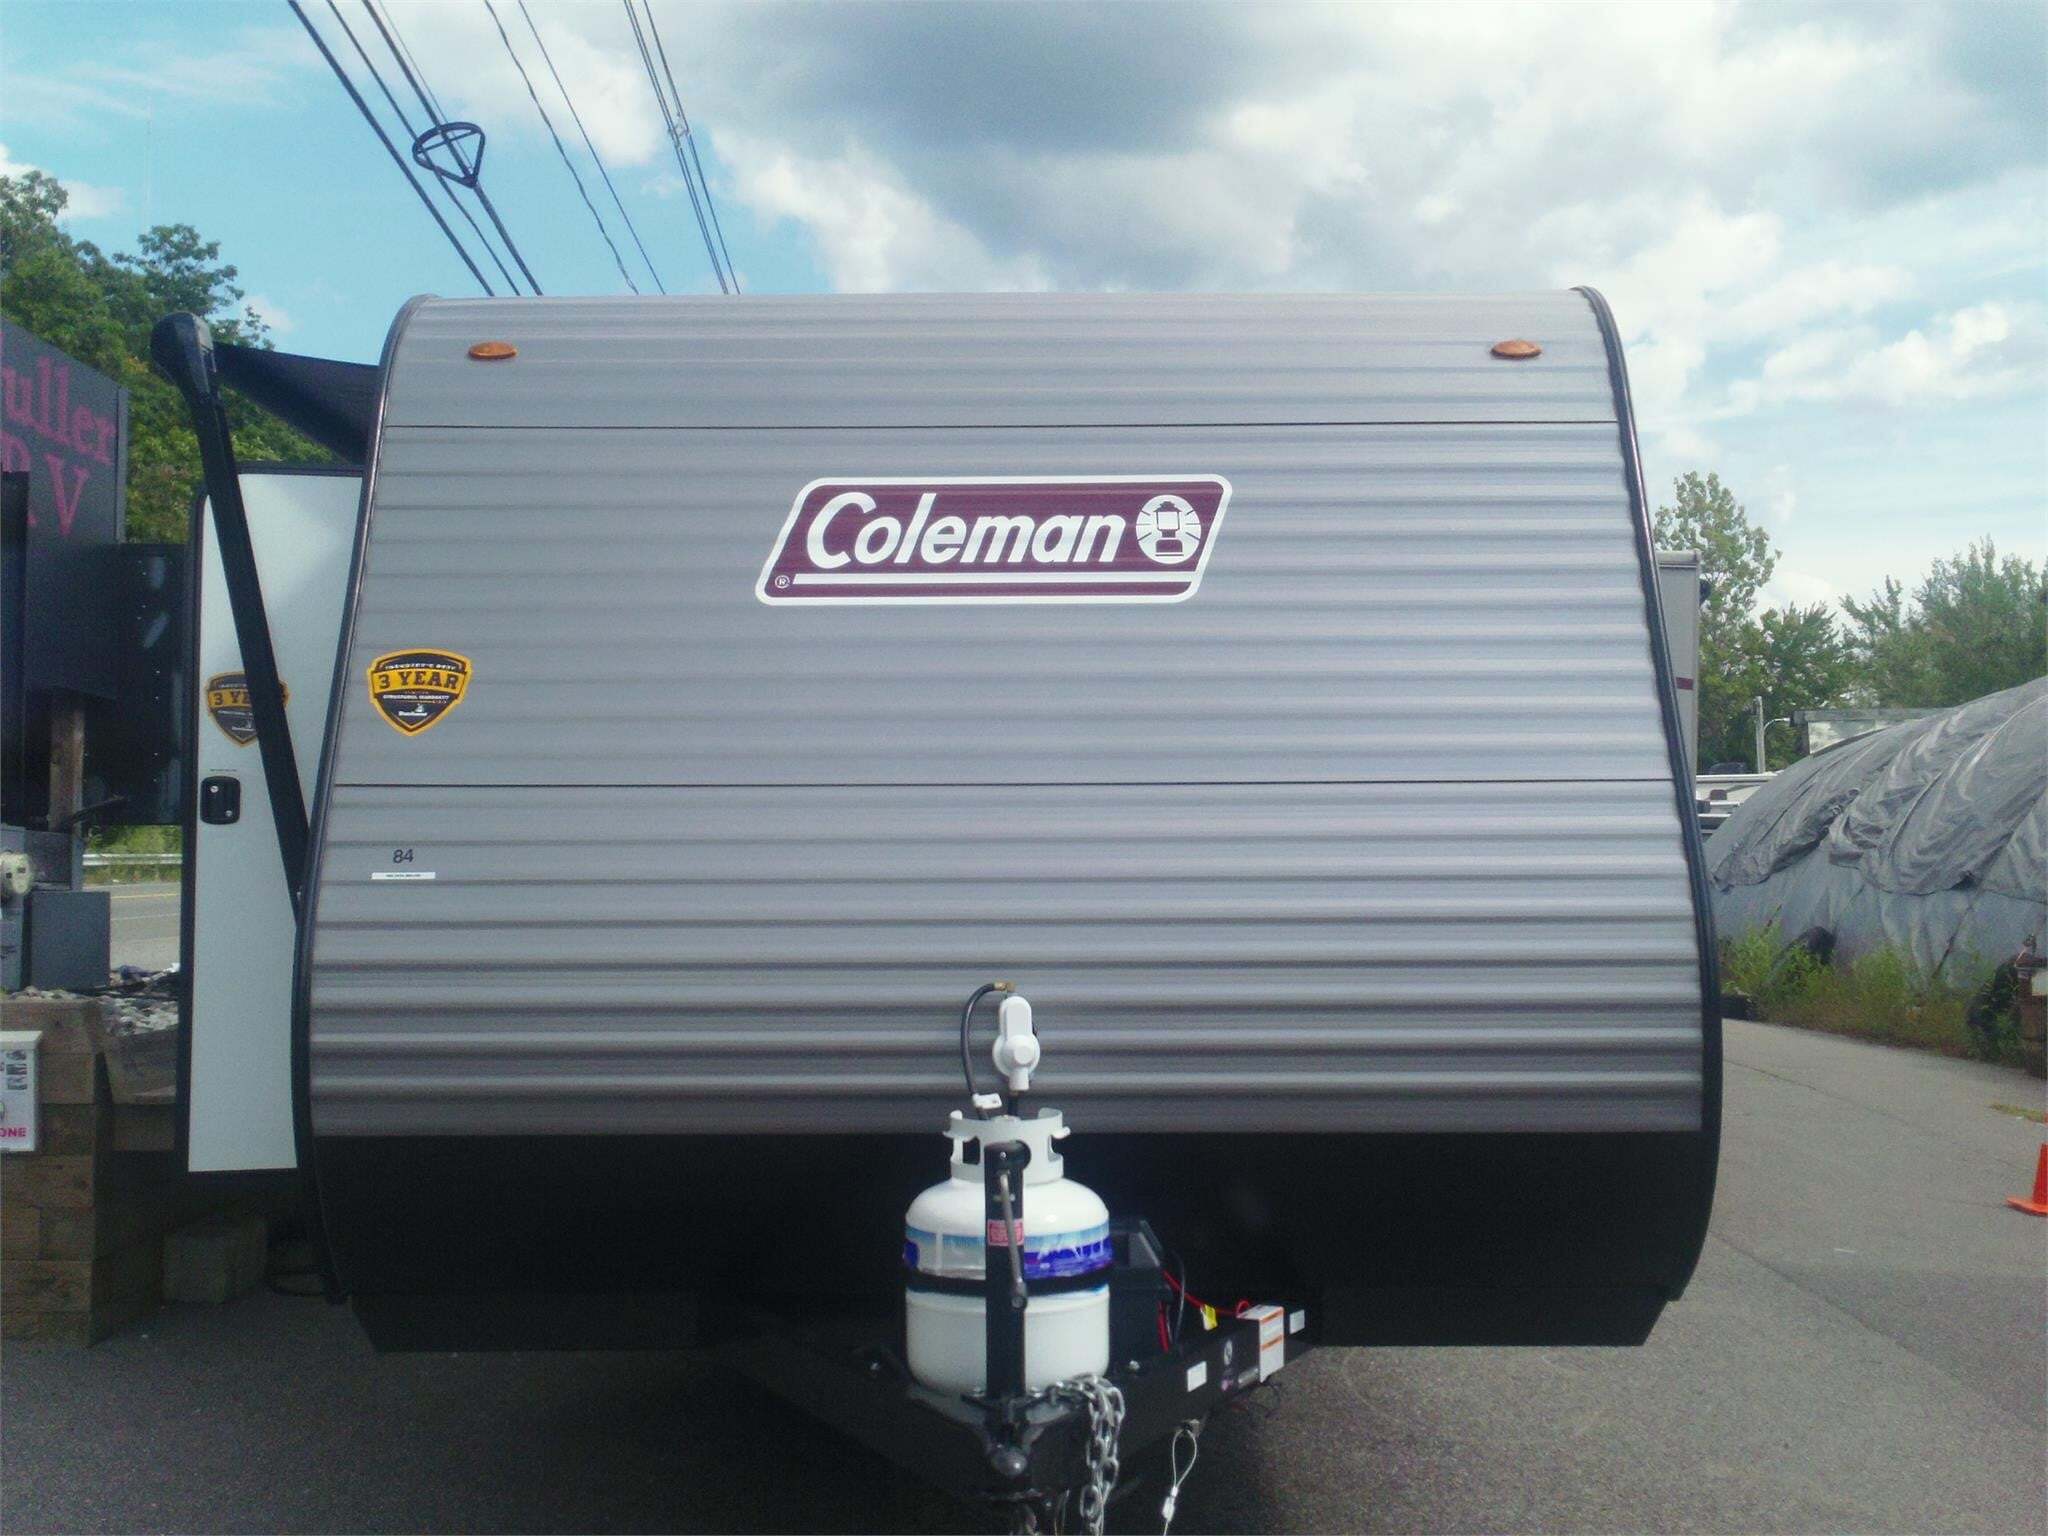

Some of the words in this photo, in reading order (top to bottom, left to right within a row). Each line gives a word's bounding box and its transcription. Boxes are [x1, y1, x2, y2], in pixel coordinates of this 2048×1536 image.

[0, 356, 118, 466] uller
[806, 491, 1127, 569] Coleman
[378, 673, 391, 689] 3
[398, 670, 460, 690] YEAR
[213, 692, 224, 706] 3
[393, 849, 414, 864] 84
